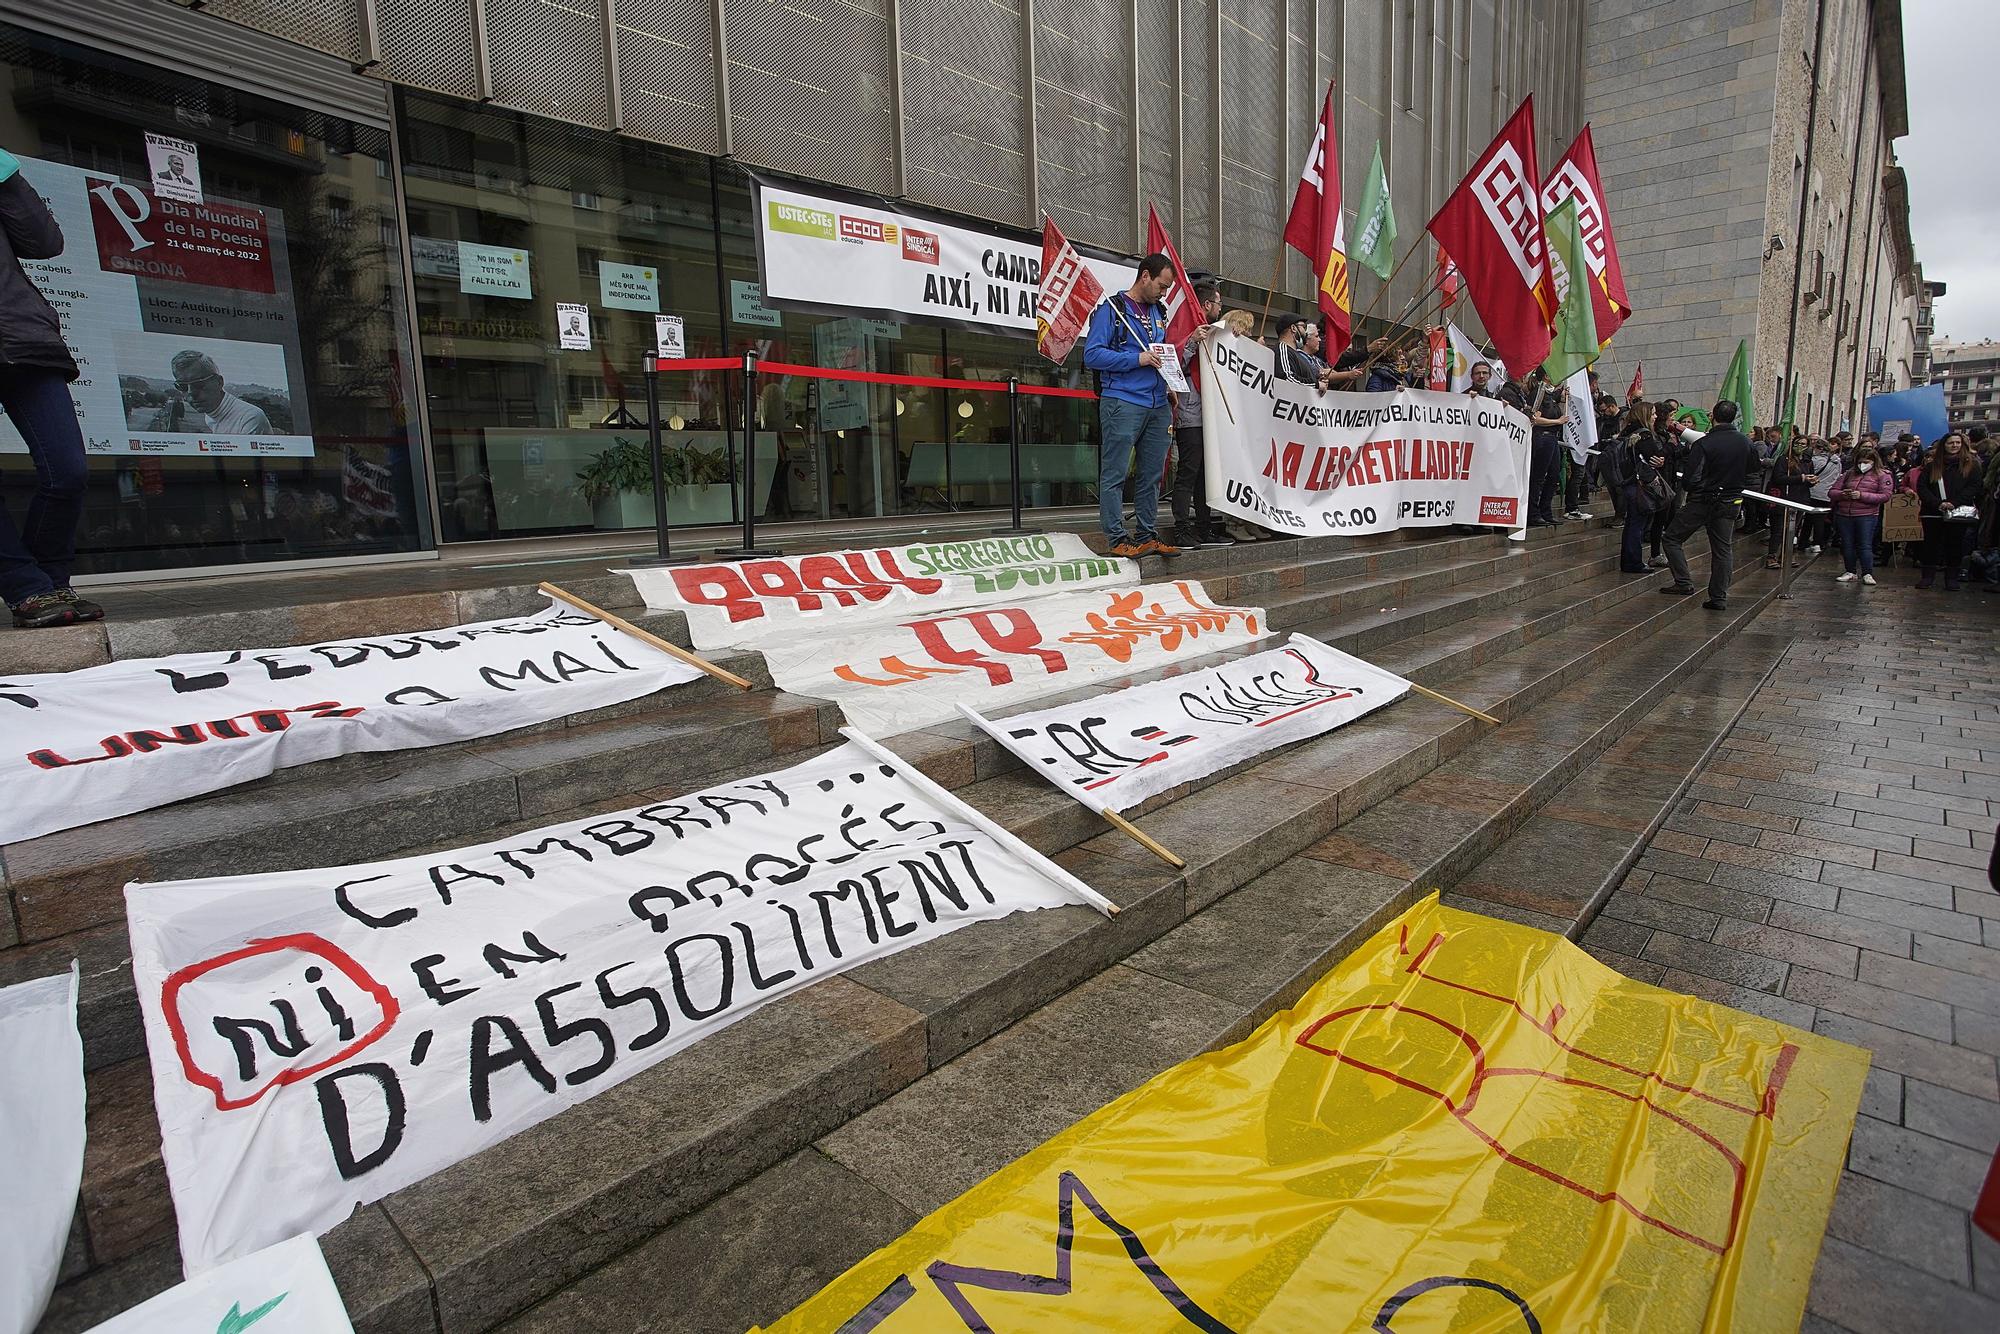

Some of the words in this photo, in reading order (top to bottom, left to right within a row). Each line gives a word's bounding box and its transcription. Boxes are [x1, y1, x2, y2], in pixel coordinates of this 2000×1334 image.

[145, 134, 196, 155] WANTED
[161, 200, 190, 218] Dia
[195, 206, 260, 231] Mundial
[164, 220, 186, 235] de
[190, 223, 206, 239] la
[210, 227, 263, 249] Poesia
[842, 220, 881, 237] CCOO
[841, 236, 864, 246] educació
[906, 234, 924, 246] INTER
[167, 238, 179, 248] 21
[182, 241, 195, 251] de
[197, 245, 221, 257] març
[223, 248, 235, 257] de
[237, 250, 260, 261] 2022
[906, 243, 935, 256] SINDICAL
[36, 261, 72, 275] cabells
[110, 255, 187, 278] GIRONA
[34, 275, 49, 283] sol
[471, 276, 496, 286] FALTA
[621, 272, 634, 280] ARA
[57, 289, 89, 299] ungla.
[923, 272, 980, 316] AIXÍ,
[987, 284, 1010, 315] NI
[148, 297, 178, 309] Lloc:
[181, 301, 231, 315] Auditori
[232, 306, 263, 320] Josep
[266, 311, 285, 321] Irla
[557, 304, 587, 314] WANTED
[151, 312, 186, 325] Hora:
[189, 316, 204, 327] 18
[206, 317, 214, 328] h
[656, 316, 682, 325] WANTED
[1429, 406, 1443, 424] LA
[1482, 508, 1512, 516] SINDICAL
[1484, 502, 1501, 510] INTER
[410, 929, 568, 1008] EN
